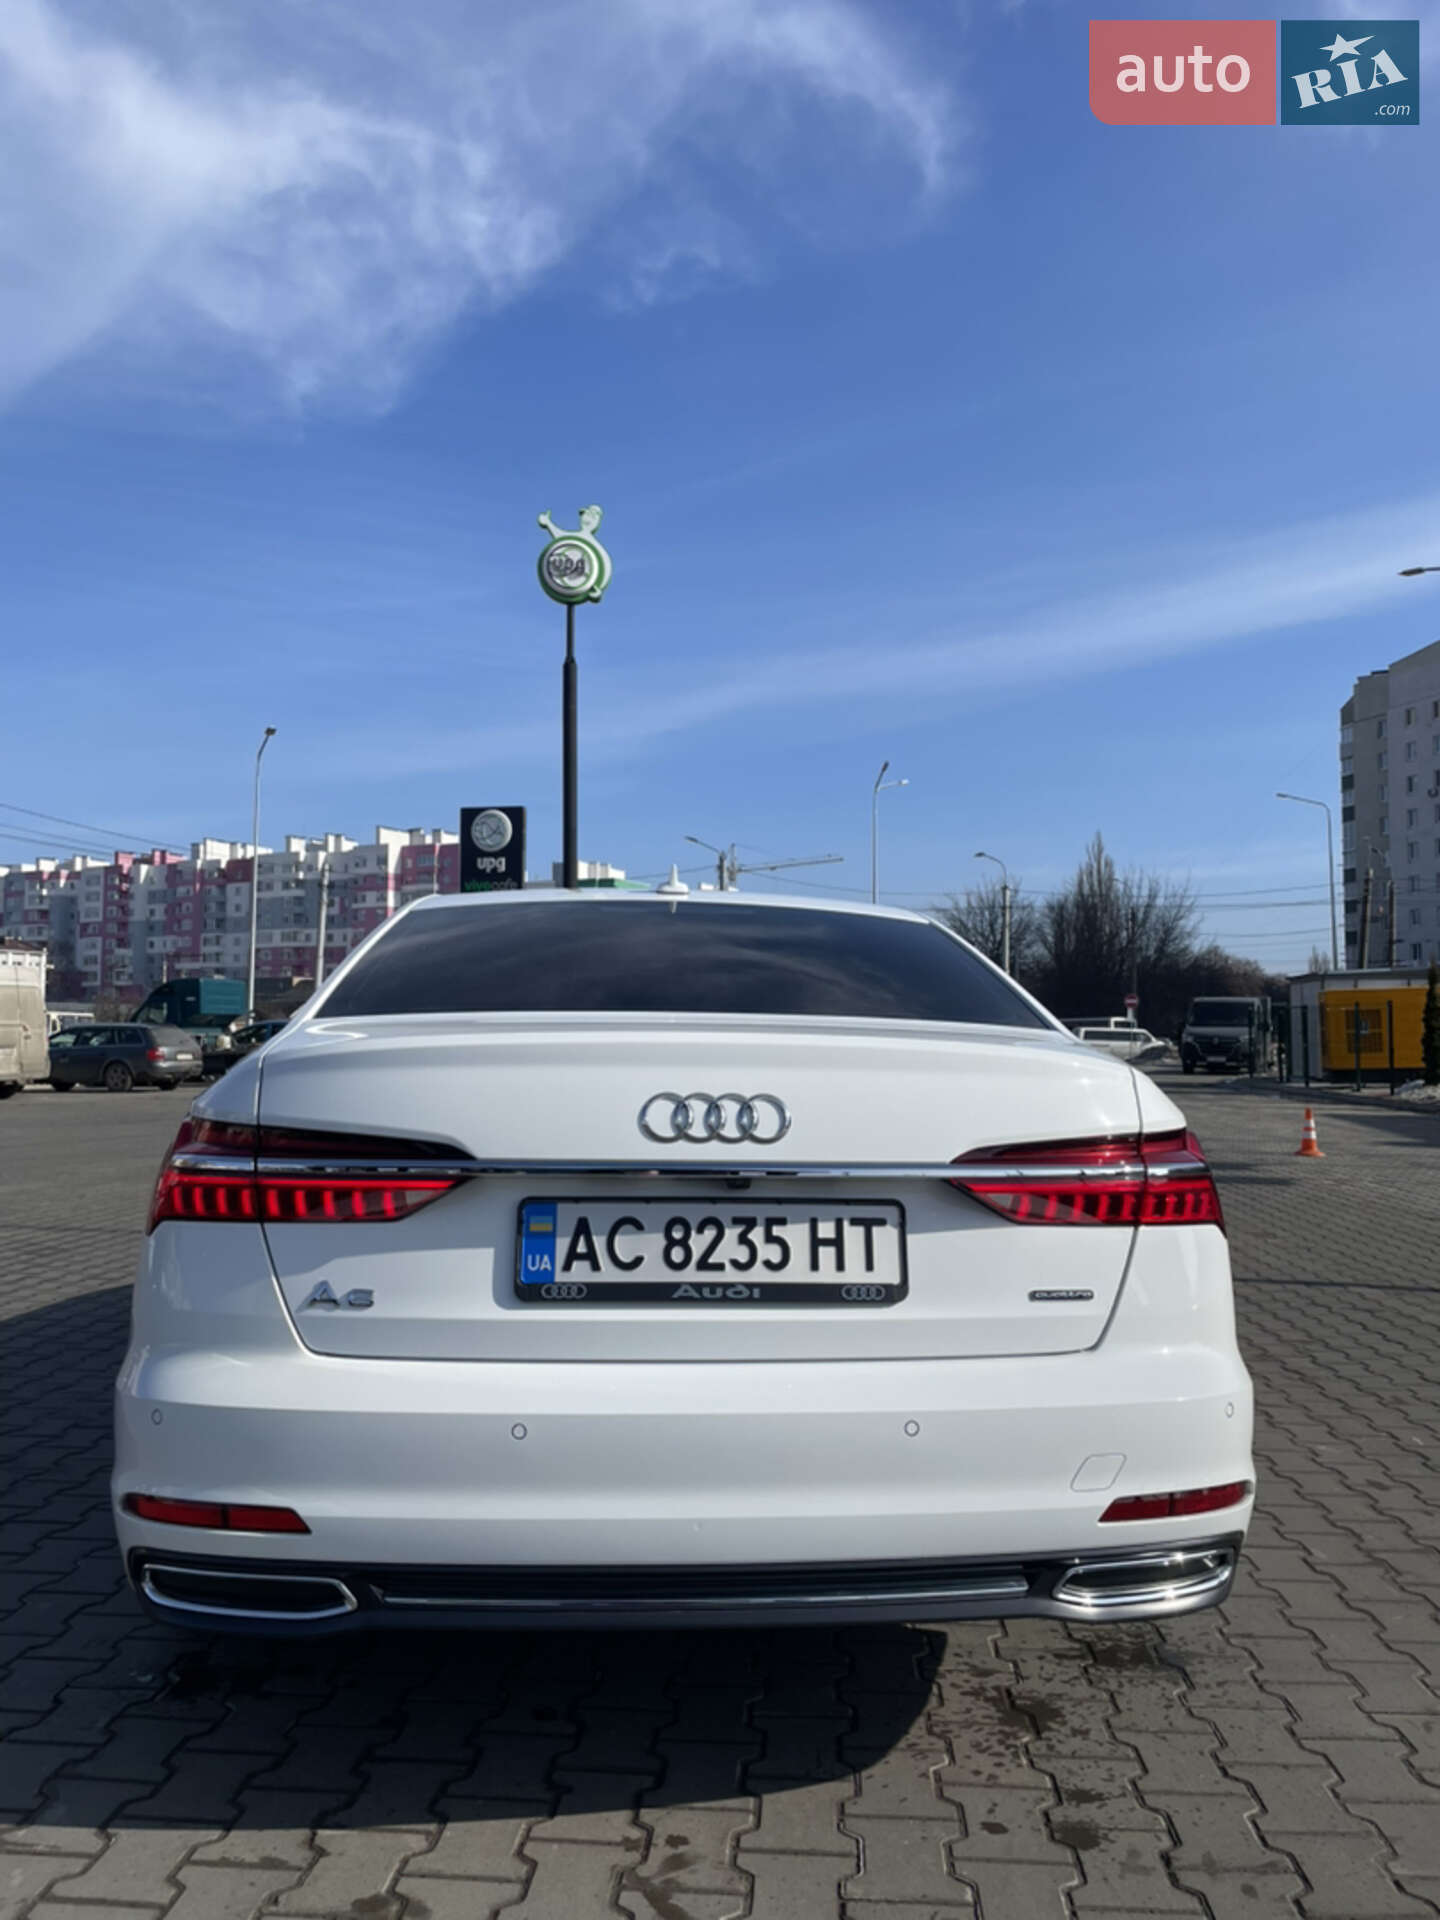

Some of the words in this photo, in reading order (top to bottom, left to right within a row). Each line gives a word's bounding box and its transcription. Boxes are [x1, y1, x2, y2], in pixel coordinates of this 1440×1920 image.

[477, 857, 506, 873] upg
[562, 1216, 645, 1272] AC
[663, 1216, 791, 1272] 8235
[810, 1217, 888, 1272] HT
[527, 1253, 552, 1271] UA
[672, 1284, 761, 1299] Audi
